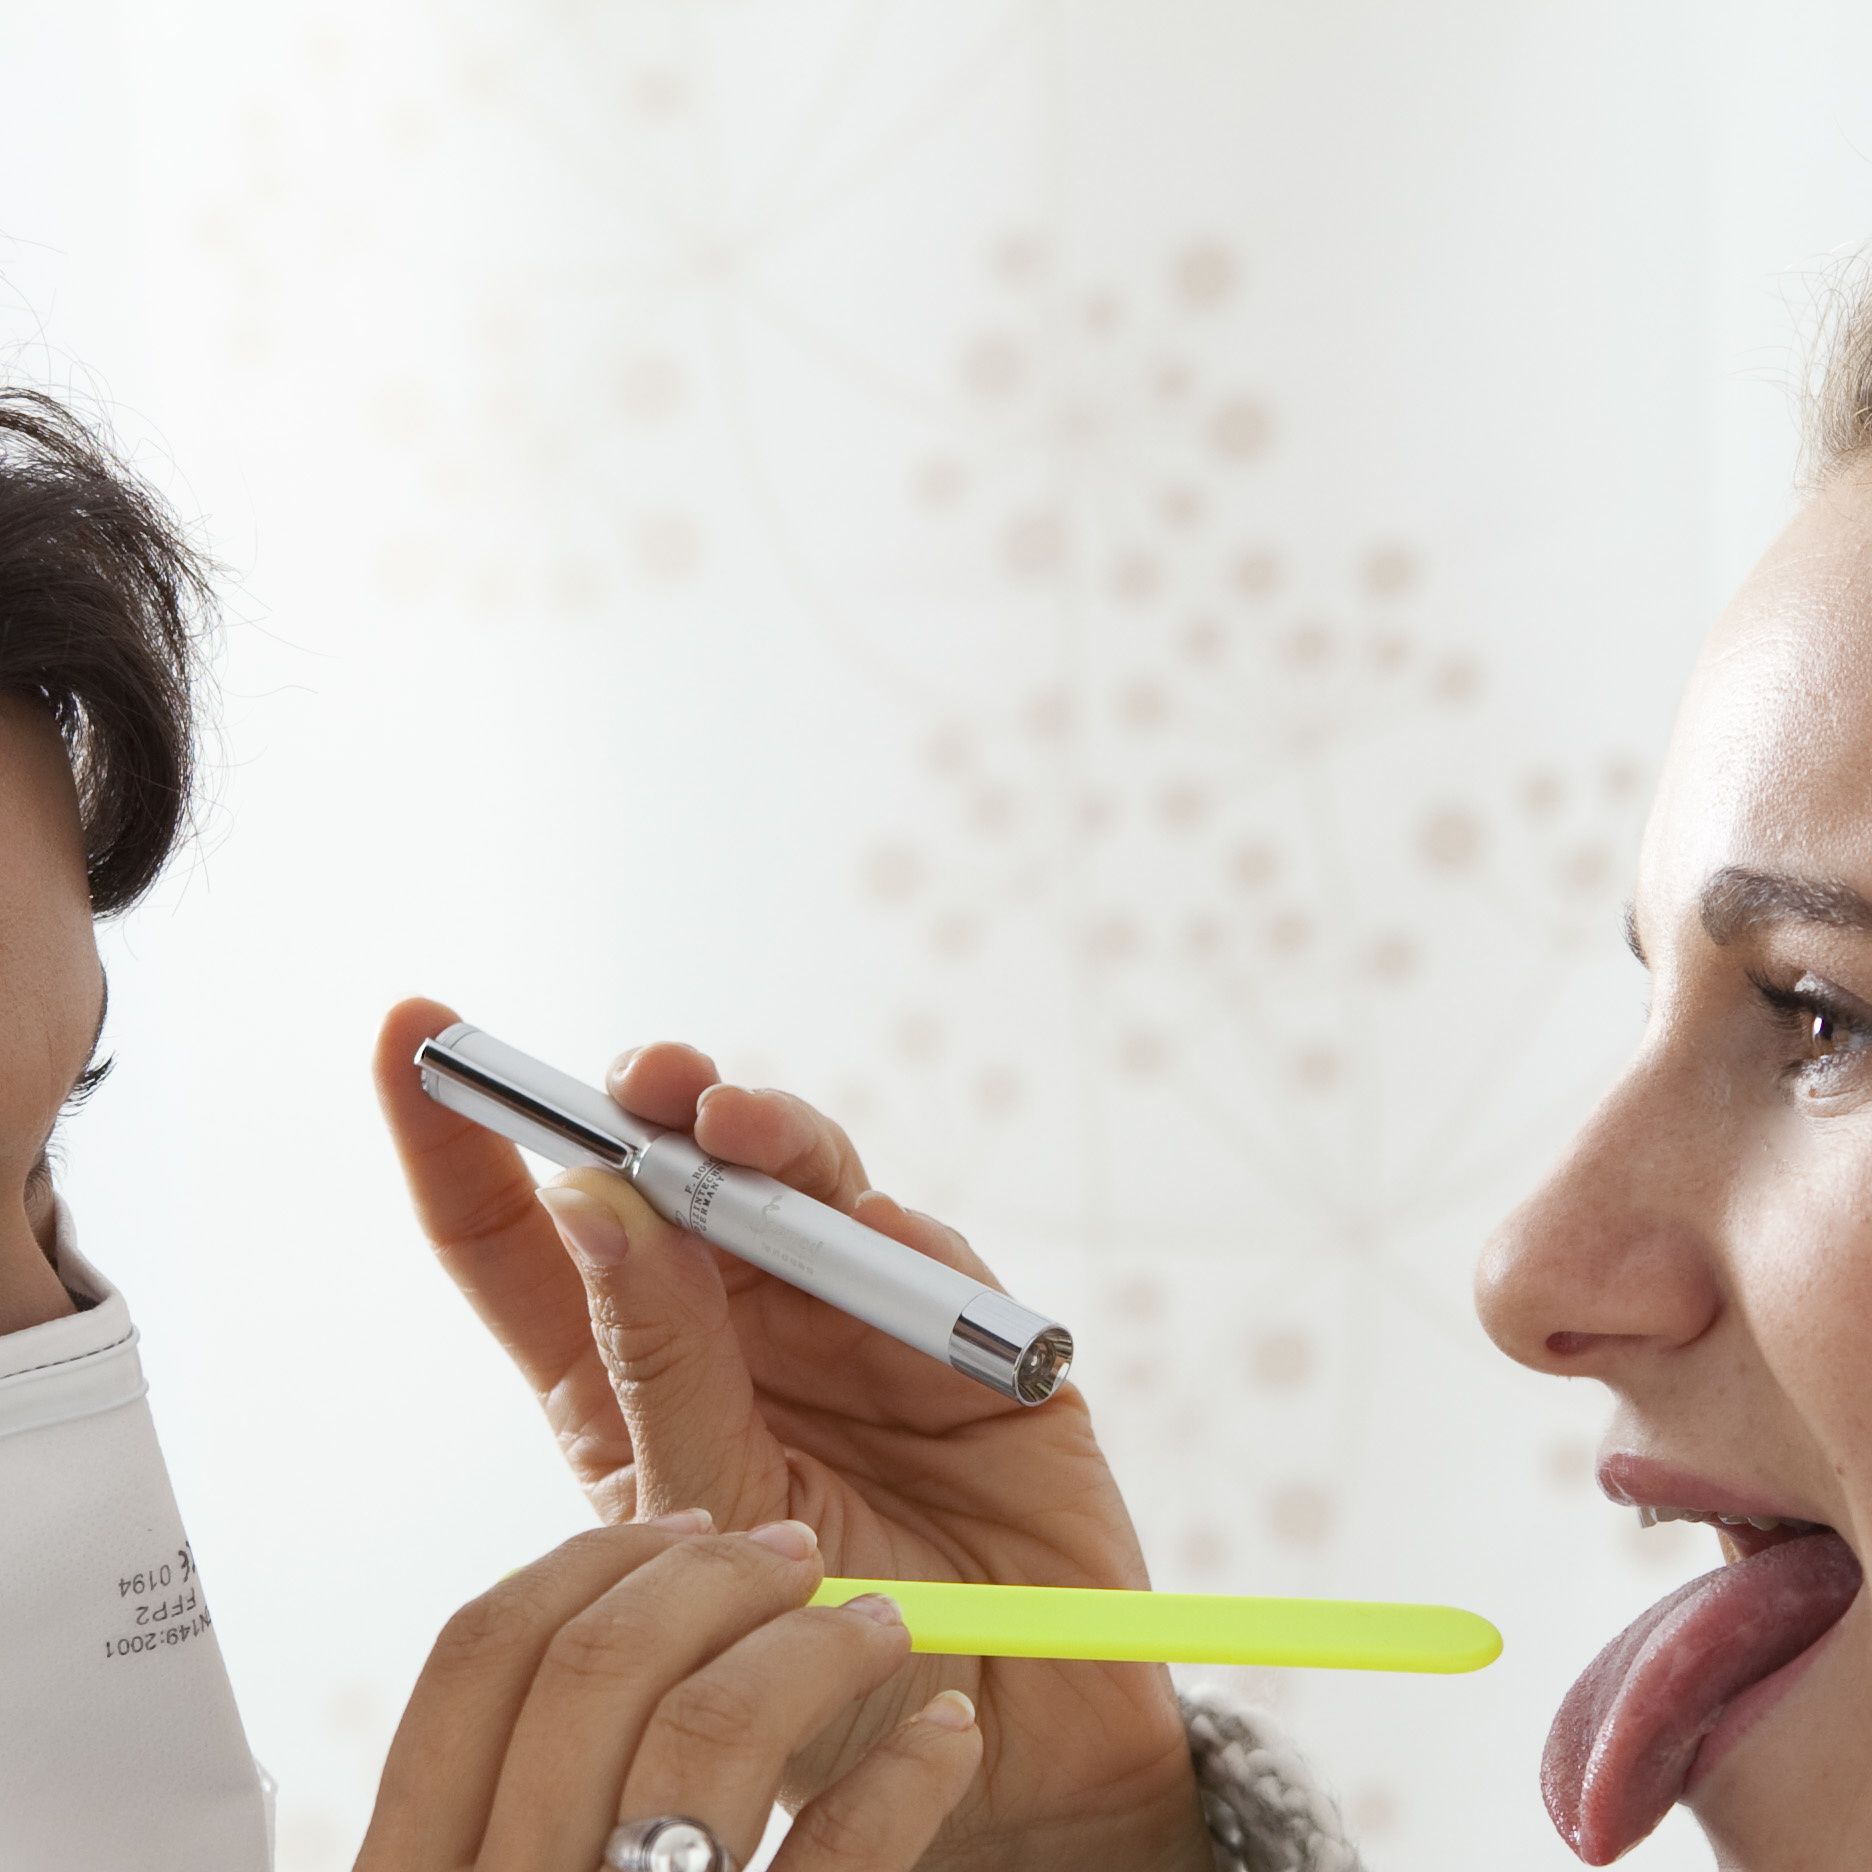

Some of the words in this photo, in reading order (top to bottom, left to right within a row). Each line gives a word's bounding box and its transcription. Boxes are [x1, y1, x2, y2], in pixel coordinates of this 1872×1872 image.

[684, 1184, 695, 1194] F.
[699, 1176, 724, 1231] GERMANY
[118, 1564, 171, 1598] 0194
[135, 1587, 196, 1626] FFP2
